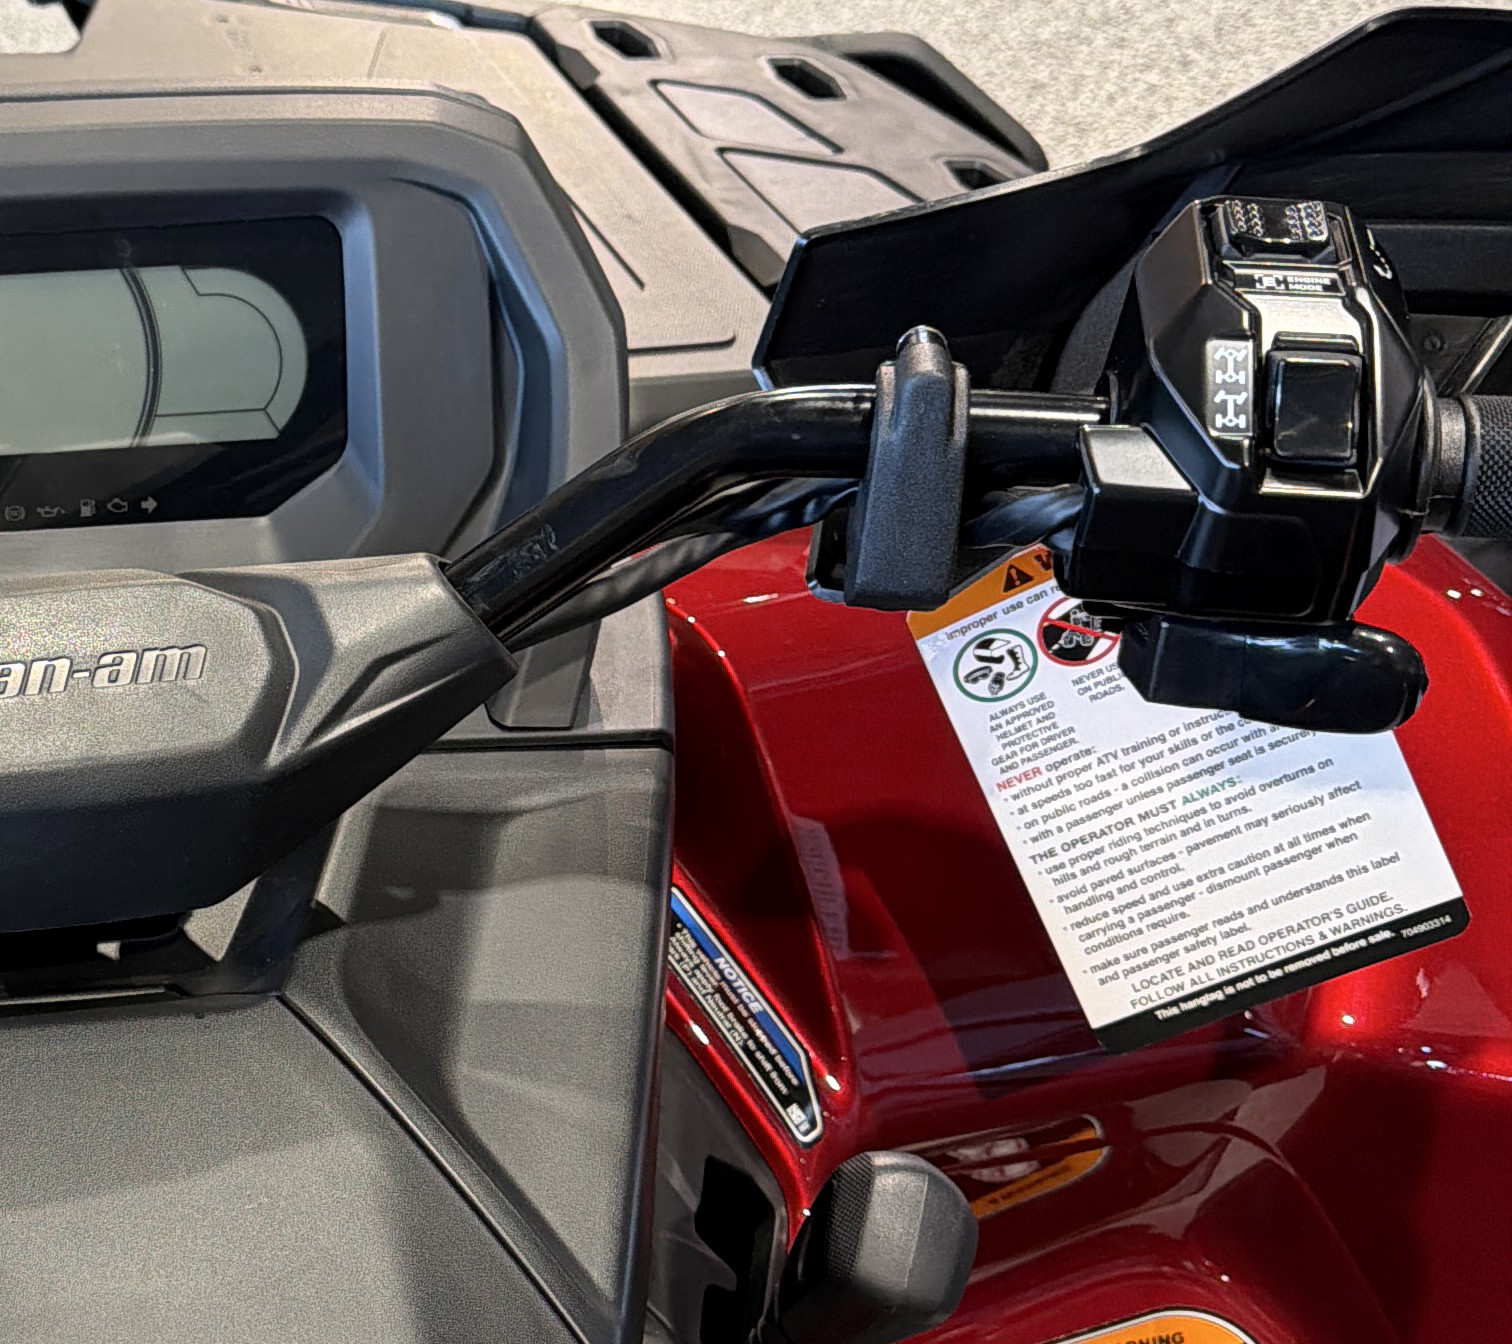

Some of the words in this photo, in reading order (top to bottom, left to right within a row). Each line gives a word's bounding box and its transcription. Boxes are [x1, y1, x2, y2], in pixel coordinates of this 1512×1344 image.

[1287, 276, 1331, 286] ENGINE
[944, 610, 998, 640] Improper
[1001, 600, 1024, 615] use
[1025, 589, 1048, 604] can
[1070, 668, 1101, 686] NEVER
[1088, 683, 1125, 703] ROADS.
[989, 700, 1026, 722] ALWAYS
[1026, 691, 1047, 705] USE
[989, 722, 1003, 733] AN
[1004, 700, 1054, 726] APPROVED
[995, 719, 1032, 741] HELMET
[1035, 711, 1055, 725] AND
[991, 749, 1018, 766] GEAR
[1018, 740, 1039, 755] FOR
[1039, 725, 1076, 746] DRIVER
[999, 760, 1019, 775] AND
[1019, 737, 1079, 766] PASSENGER.
[1000, 720, 1059, 751] PROTECTIVE
[995, 766, 1042, 792] NEVER
[1044, 745, 1097, 772] operate:
[1009, 777, 1054, 801] without
[1055, 762, 1092, 785] proper
[1096, 749, 1118, 767] ATV
[1120, 733, 1167, 756] training
[1168, 726, 1180, 737] or
[1028, 846, 1058, 864] THE
[1060, 816, 1135, 852] OPERATOR
[1137, 799, 1176, 822] MUST
[1182, 775, 1242, 805] ALWAYS:
[1056, 883, 1088, 903] avoid
[1089, 869, 1125, 892] paved
[1126, 851, 1176, 876] surfaces
[1185, 824, 1242, 856] pavement
[1243, 816, 1268, 831] may
[1270, 794, 1324, 821] seriously
[1327, 780, 1362, 800] affect
[1063, 890, 1115, 915] handling
[1115, 879, 1138, 895] and
[1139, 862, 1185, 885] control.
[1129, 981, 1184, 1009] FOLLOW
[1189, 972, 1215, 988] ALL
[1215, 934, 1315, 977] INSTRUCTIONS
[1317, 930, 1328, 941] &
[1327, 903, 1408, 936] WARNINGS.
[1130, 965, 1185, 992] LOCATE
[1188, 954, 1215, 972] AND
[1217, 939, 1255, 960] READ
[1257, 907, 1344, 945] OPERATOR'S
[1345, 890, 1394, 914] GUIDE.
[714, 956, 764, 1014] NOTICE
[1153, 1006, 1180, 1020] This
[1178, 989, 1225, 1011] hangtag
[1222, 985, 1236, 995] is
[1235, 977, 1256, 991] not
[1254, 973, 1268, 983] to
[1266, 968, 1283, 979] be
[1283, 949, 1331, 973] removed
[1330, 938, 1367, 956] before
[1367, 929, 1395, 944] sale.
